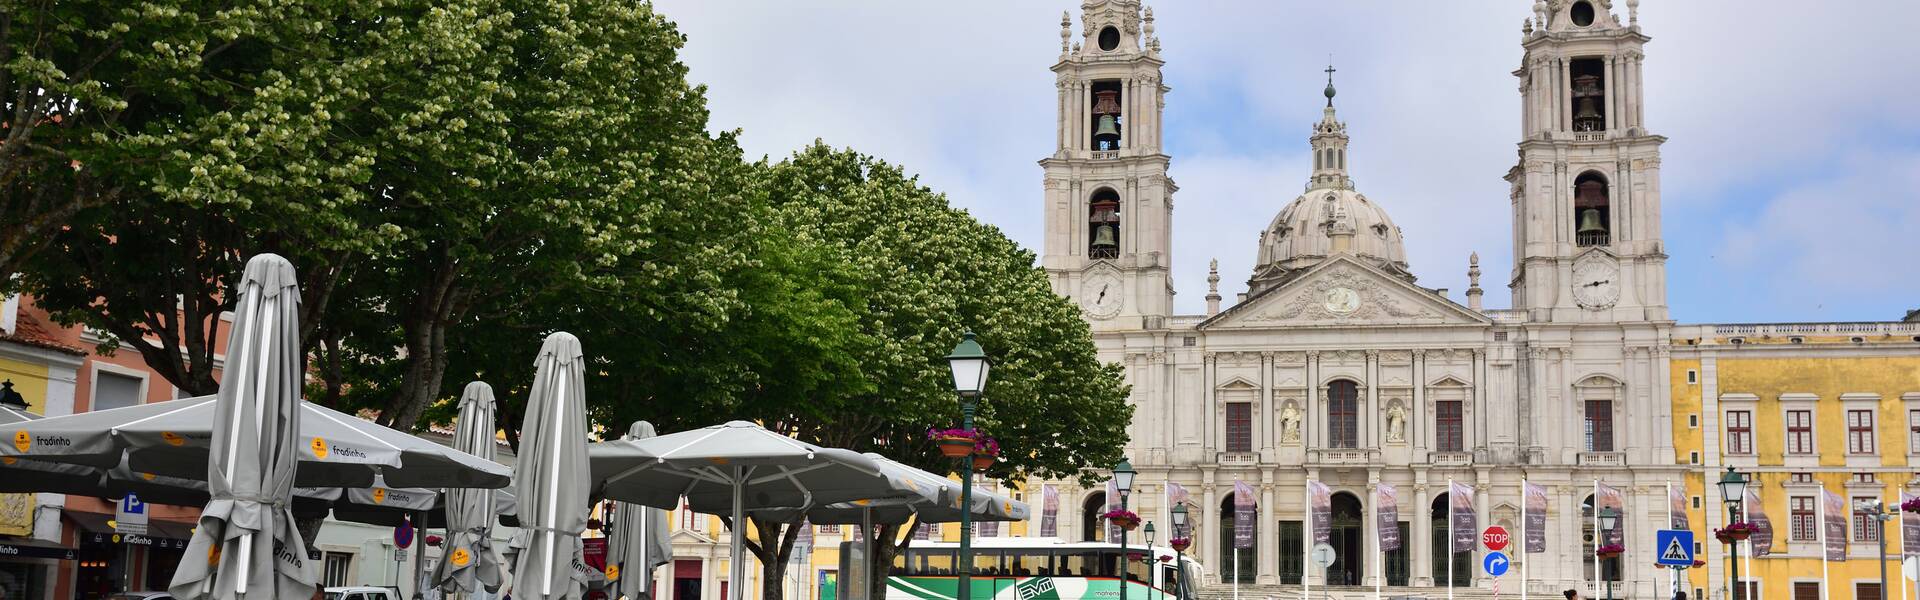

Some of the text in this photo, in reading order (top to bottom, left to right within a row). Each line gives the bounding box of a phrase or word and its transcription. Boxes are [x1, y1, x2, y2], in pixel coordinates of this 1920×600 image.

[36, 435, 71, 447] fradinho
[332, 444, 367, 459] fradinho
[127, 494, 140, 512] P
[1483, 533, 1509, 544] STOP
